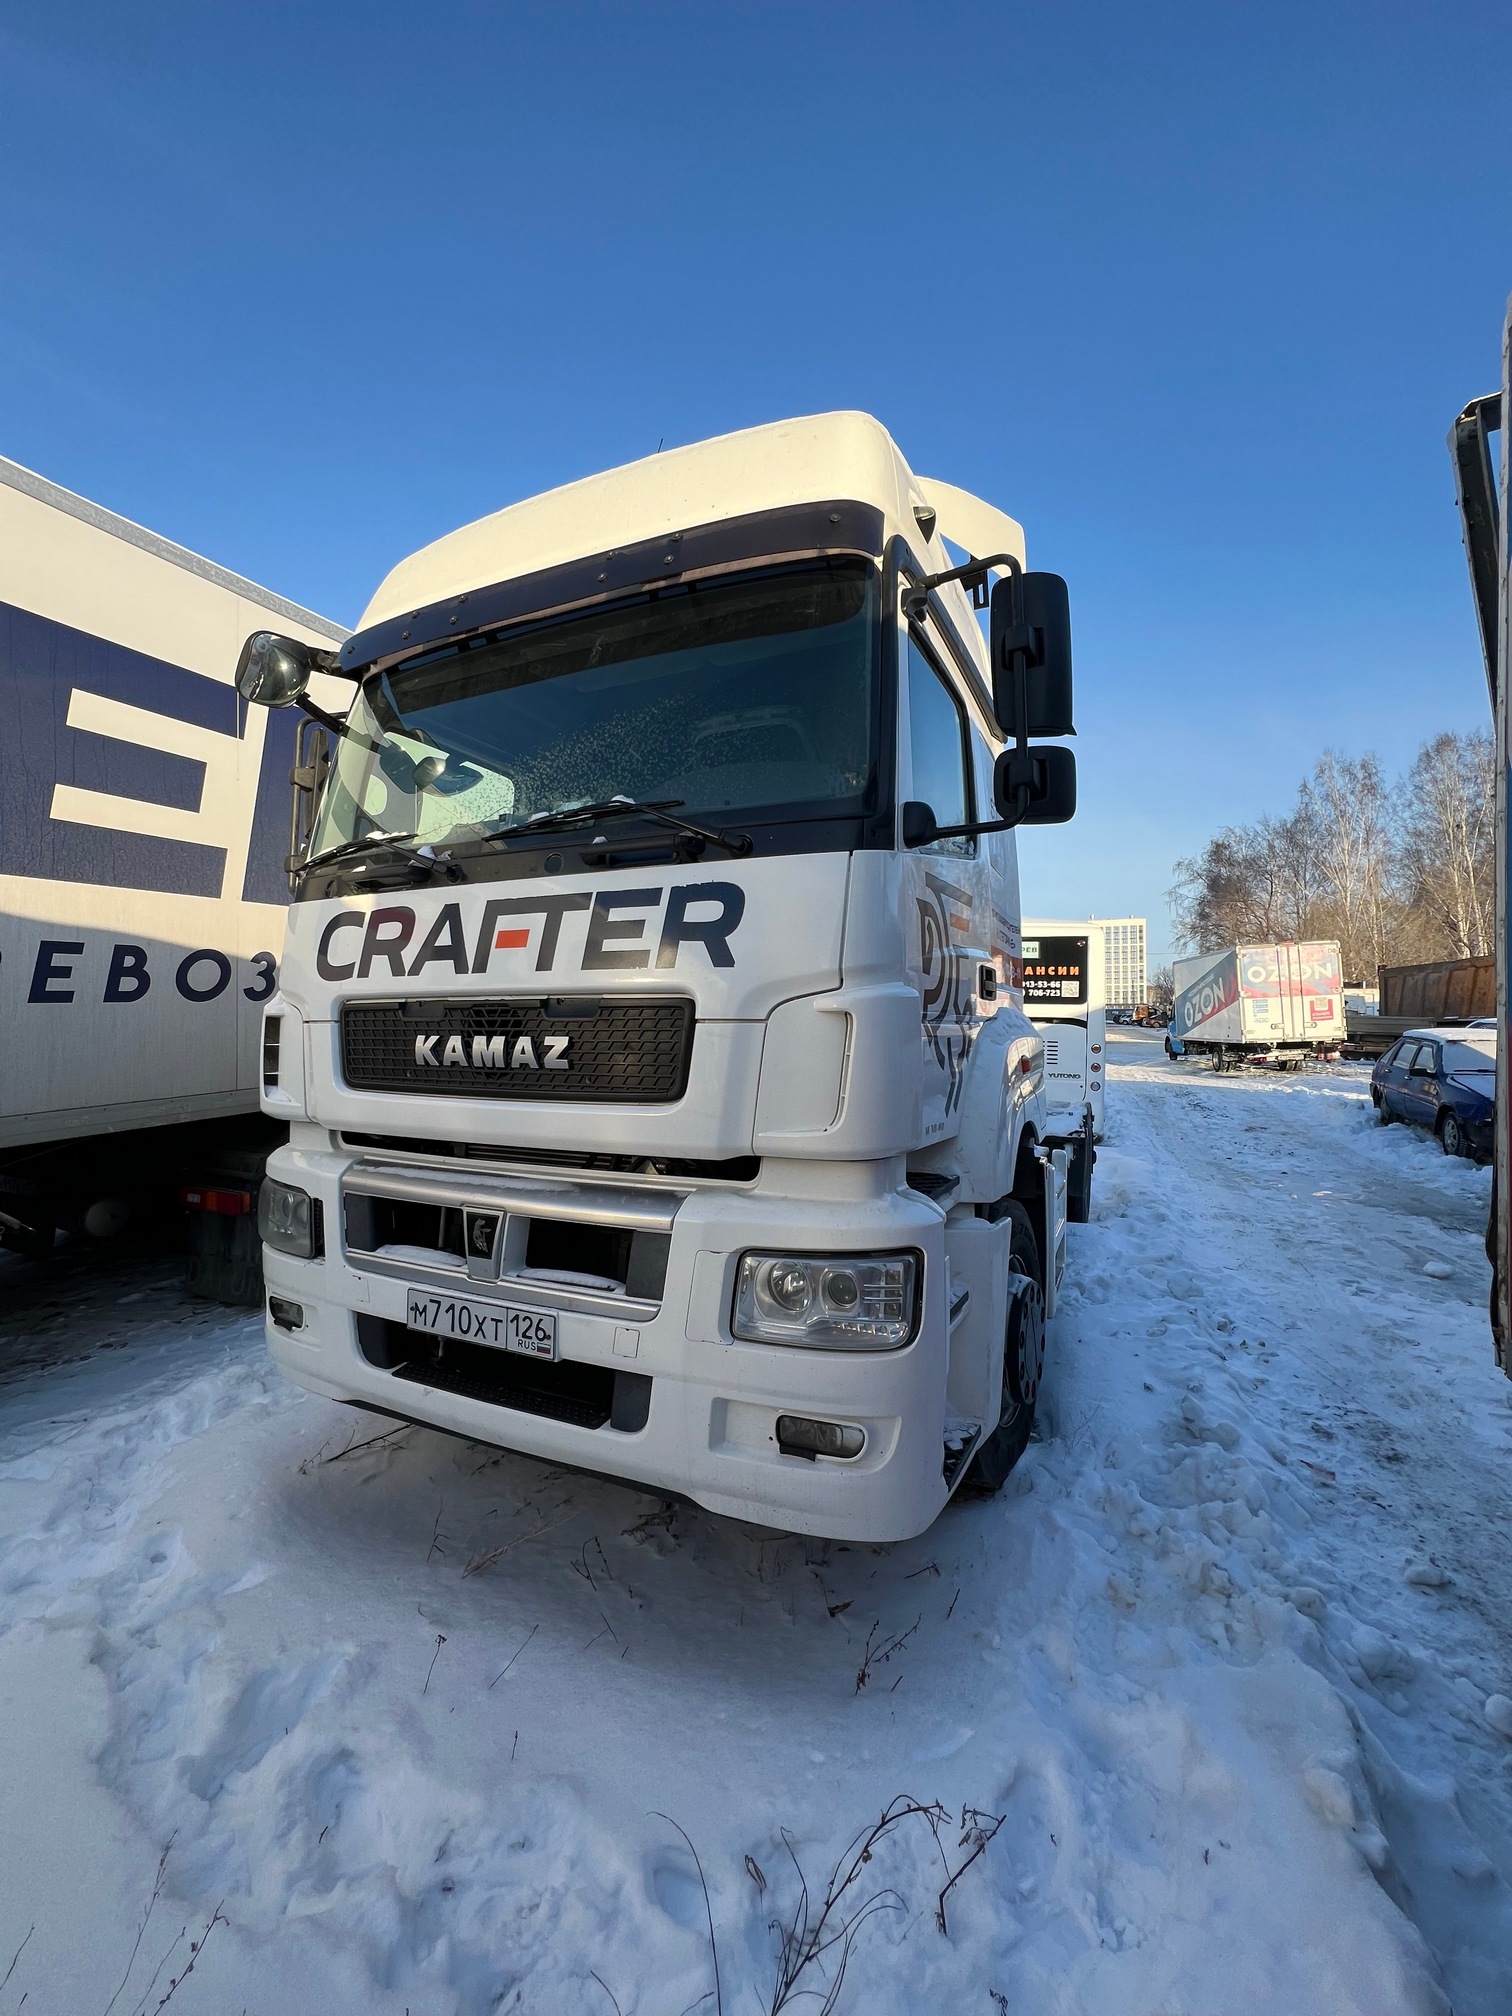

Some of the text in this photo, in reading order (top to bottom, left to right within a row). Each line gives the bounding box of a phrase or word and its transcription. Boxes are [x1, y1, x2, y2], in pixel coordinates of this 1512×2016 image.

[316, 881, 746, 982] CRAFTER
[0, 939, 277, 1003] ЕВОЗ
[1247, 962, 1332, 983] OZON
[1184, 977, 1226, 1028] OZON
[414, 1034, 574, 1070] KAMAZ
[510, 1314, 547, 1342] 126
[518, 1339, 536, 1351] RUS
